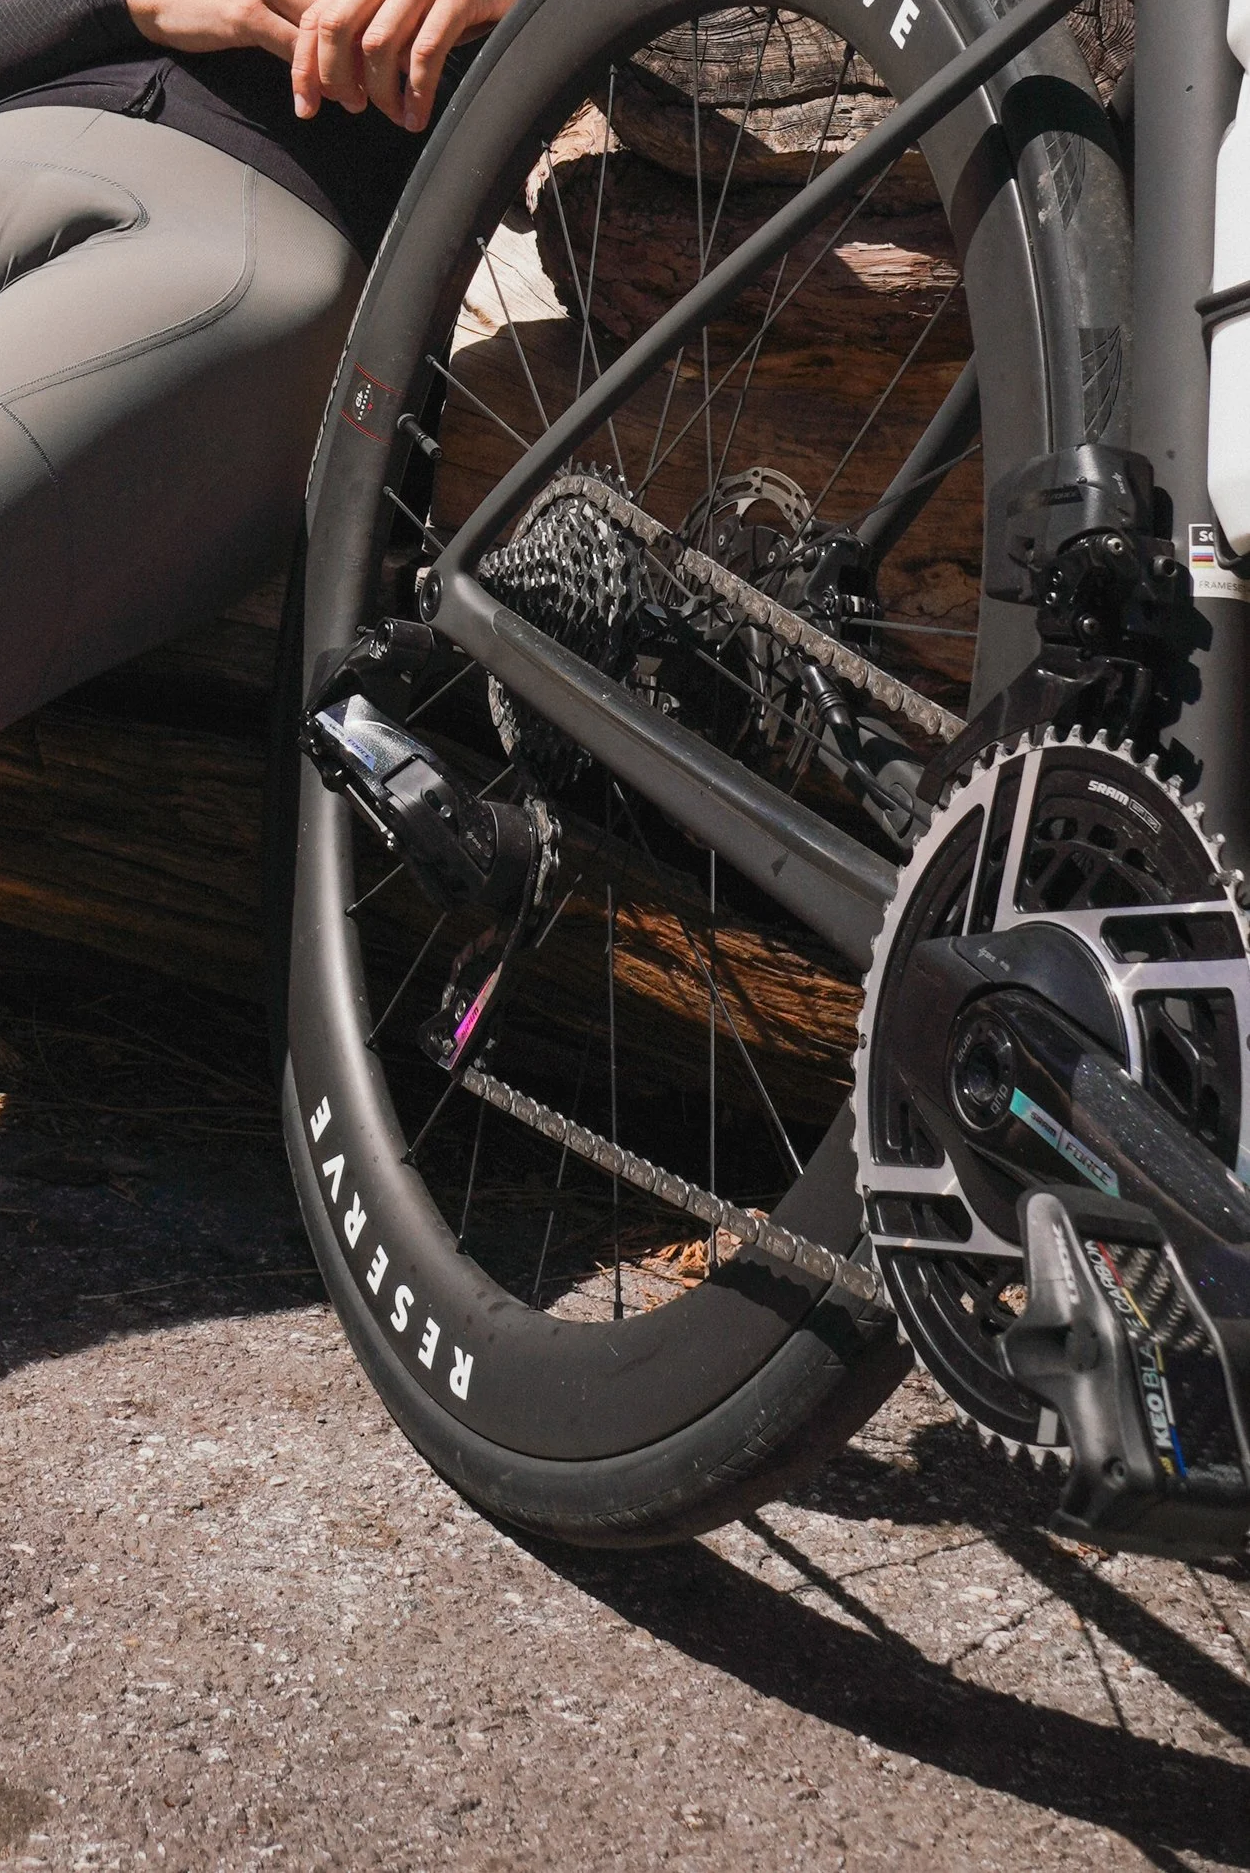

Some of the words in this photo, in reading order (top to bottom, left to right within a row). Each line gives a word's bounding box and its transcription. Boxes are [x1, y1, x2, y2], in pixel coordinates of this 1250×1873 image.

[1198, 580, 1246, 593] FRAMESE
[1087, 779, 1129, 806] SRAM
[1065, 1131, 1112, 1183] FORCE
[310, 1096, 474, 1400] RESERVE
[1145, 1391, 1174, 1449] KEO
